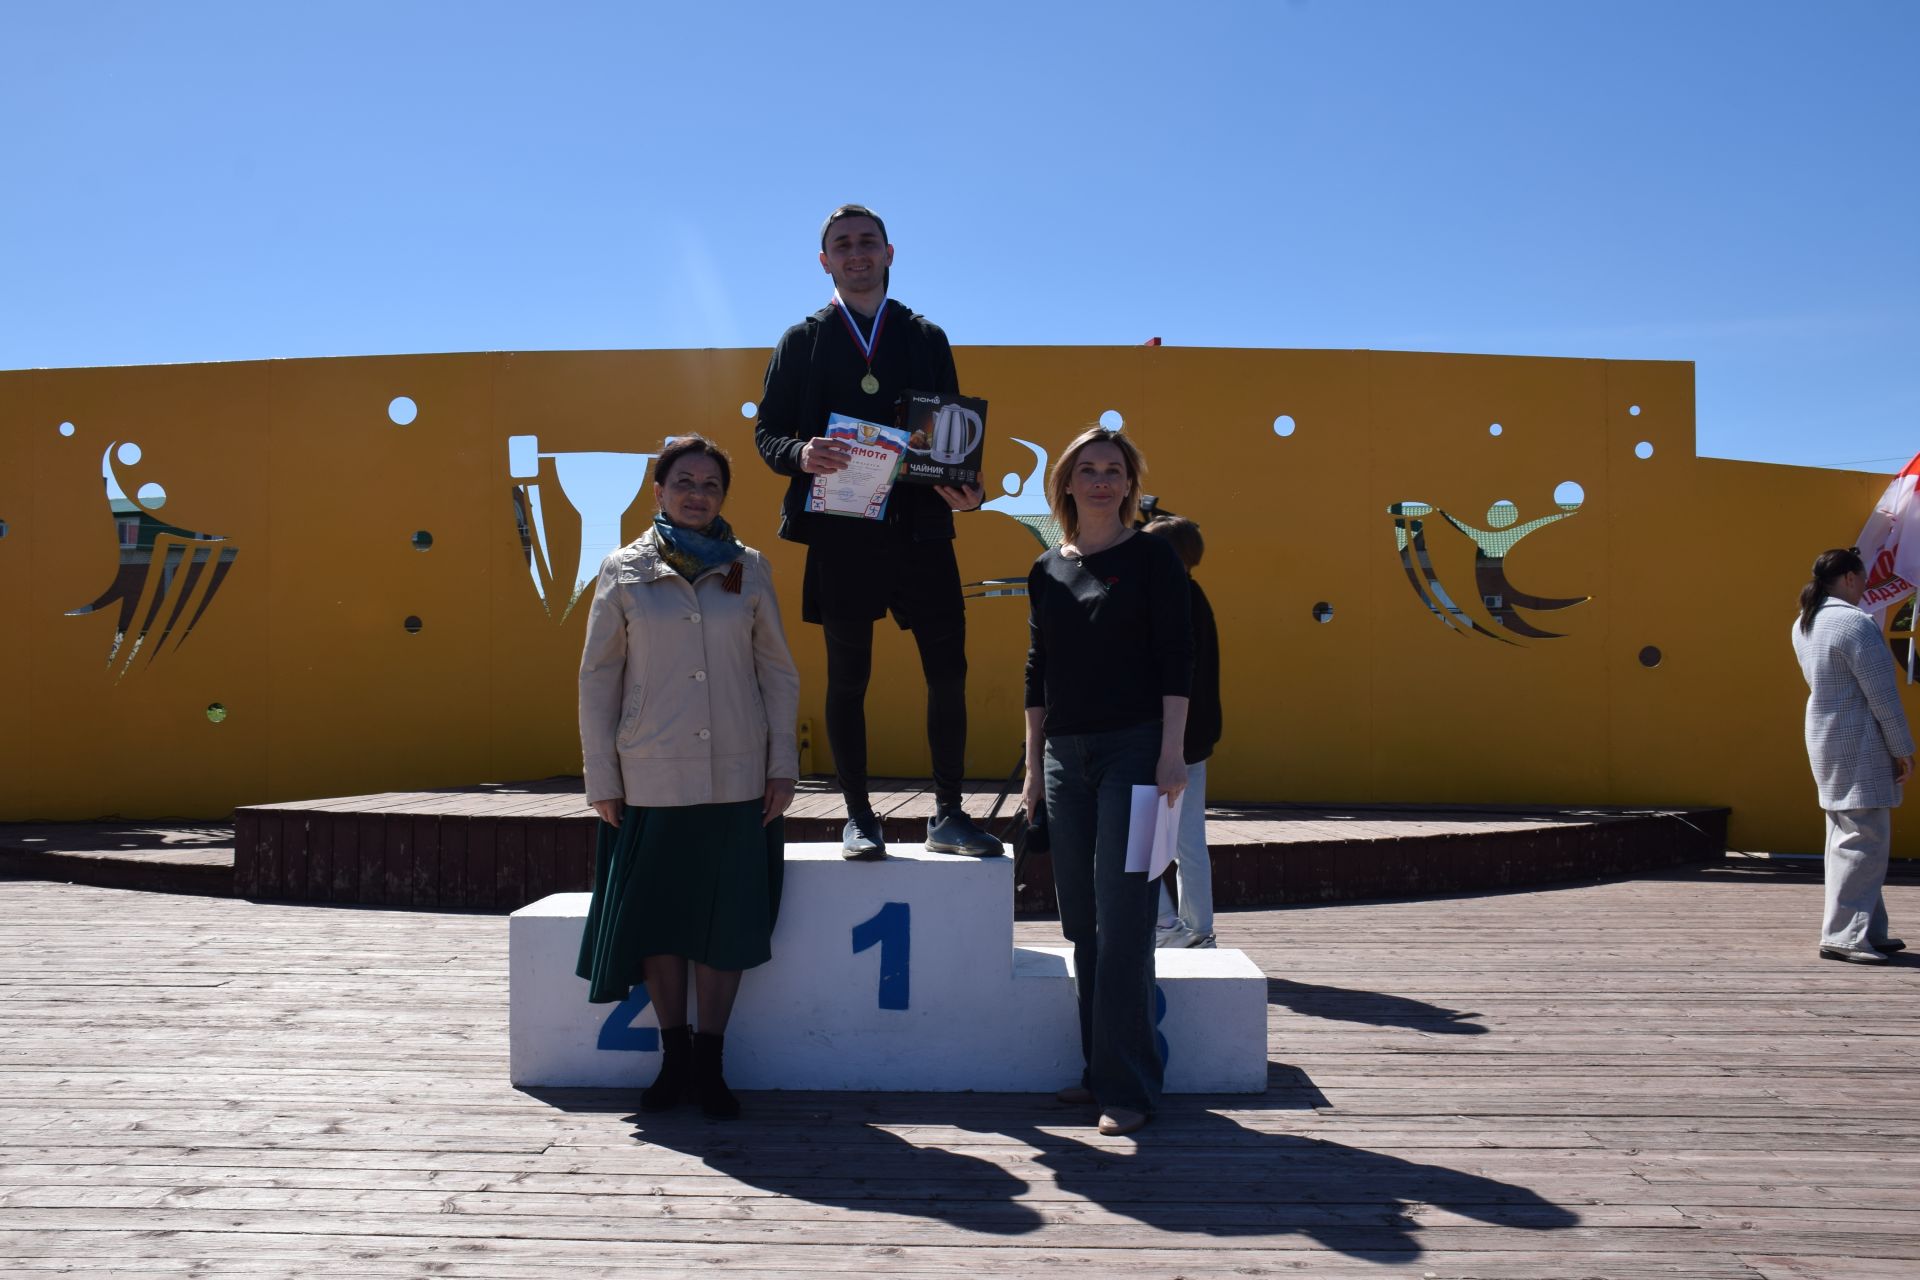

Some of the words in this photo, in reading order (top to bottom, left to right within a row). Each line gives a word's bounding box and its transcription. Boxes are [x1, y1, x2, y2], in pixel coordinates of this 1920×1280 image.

[840, 446, 888, 461] АМОТА
[910, 463, 944, 475] ЧАЙНИК
[852, 902, 910, 1010] 1
